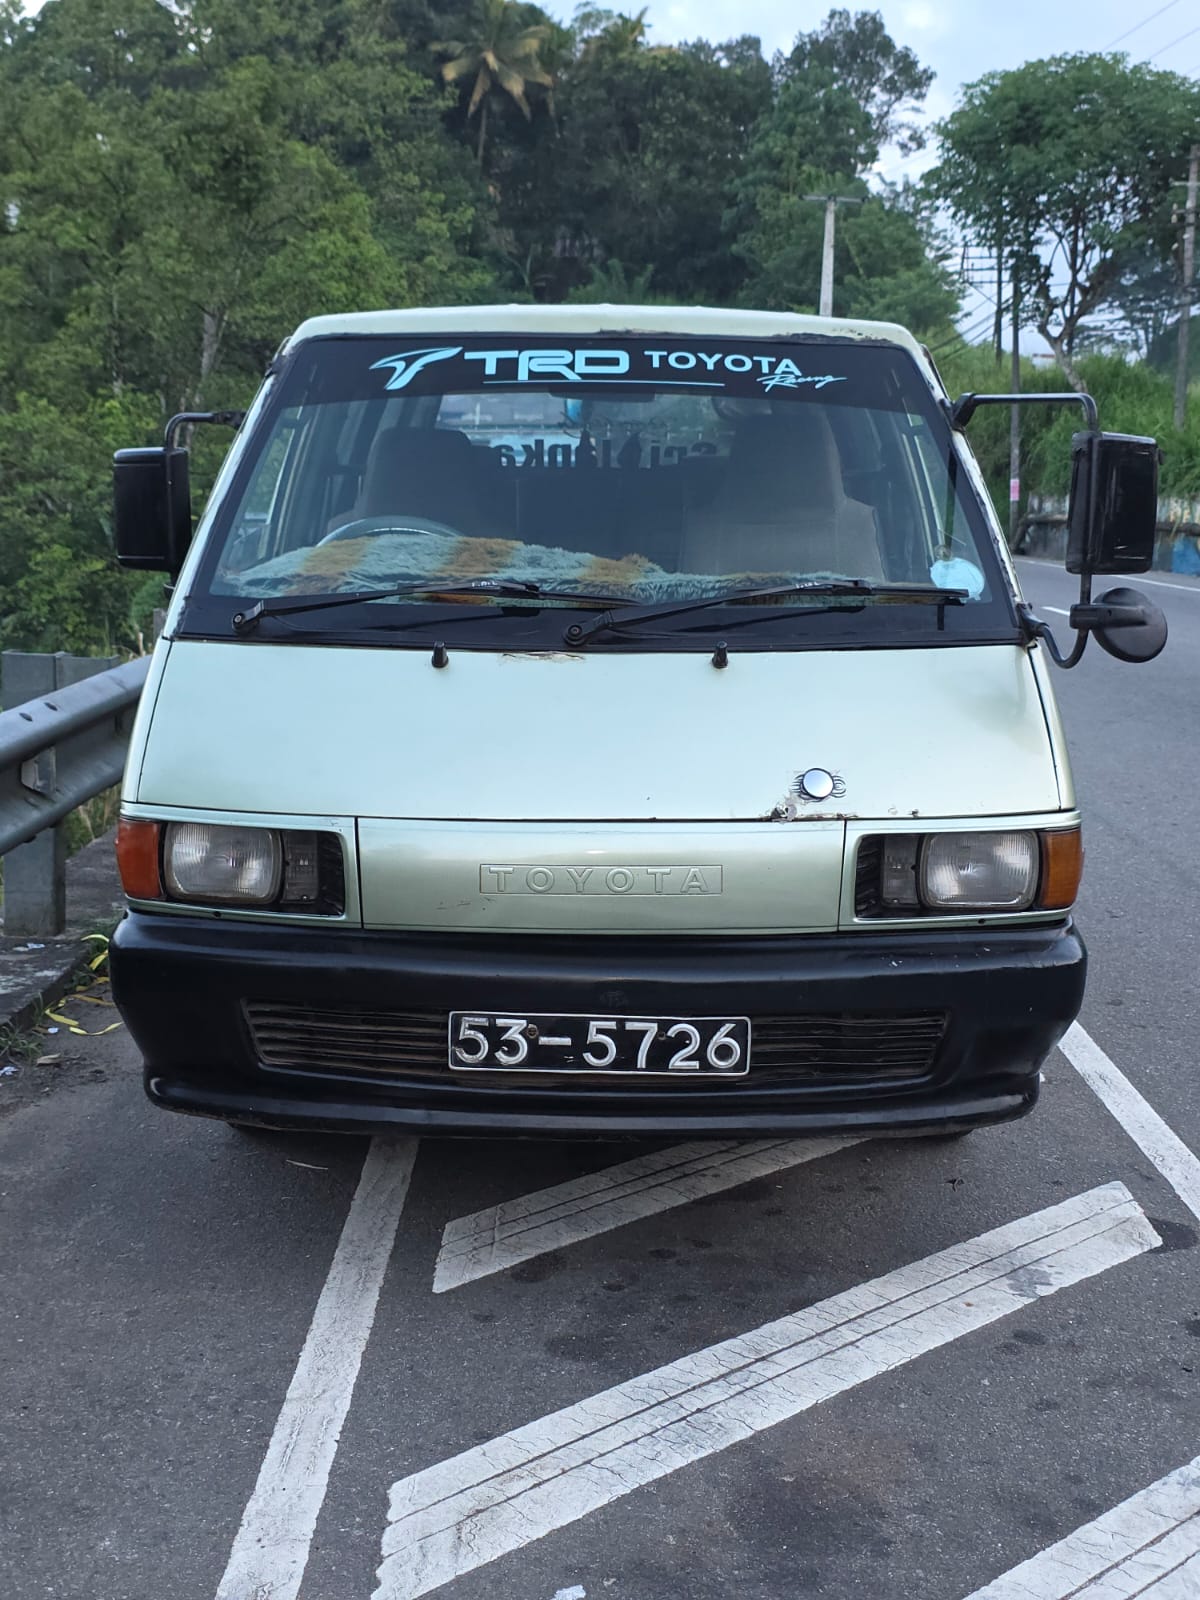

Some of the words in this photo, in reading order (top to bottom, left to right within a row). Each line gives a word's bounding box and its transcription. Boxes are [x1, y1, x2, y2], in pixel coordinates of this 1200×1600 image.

[464, 350, 629, 381] TRD
[644, 351, 802, 376] TOYOTA
[756, 374, 848, 392] Racing
[489, 867, 709, 893] TOYOTA
